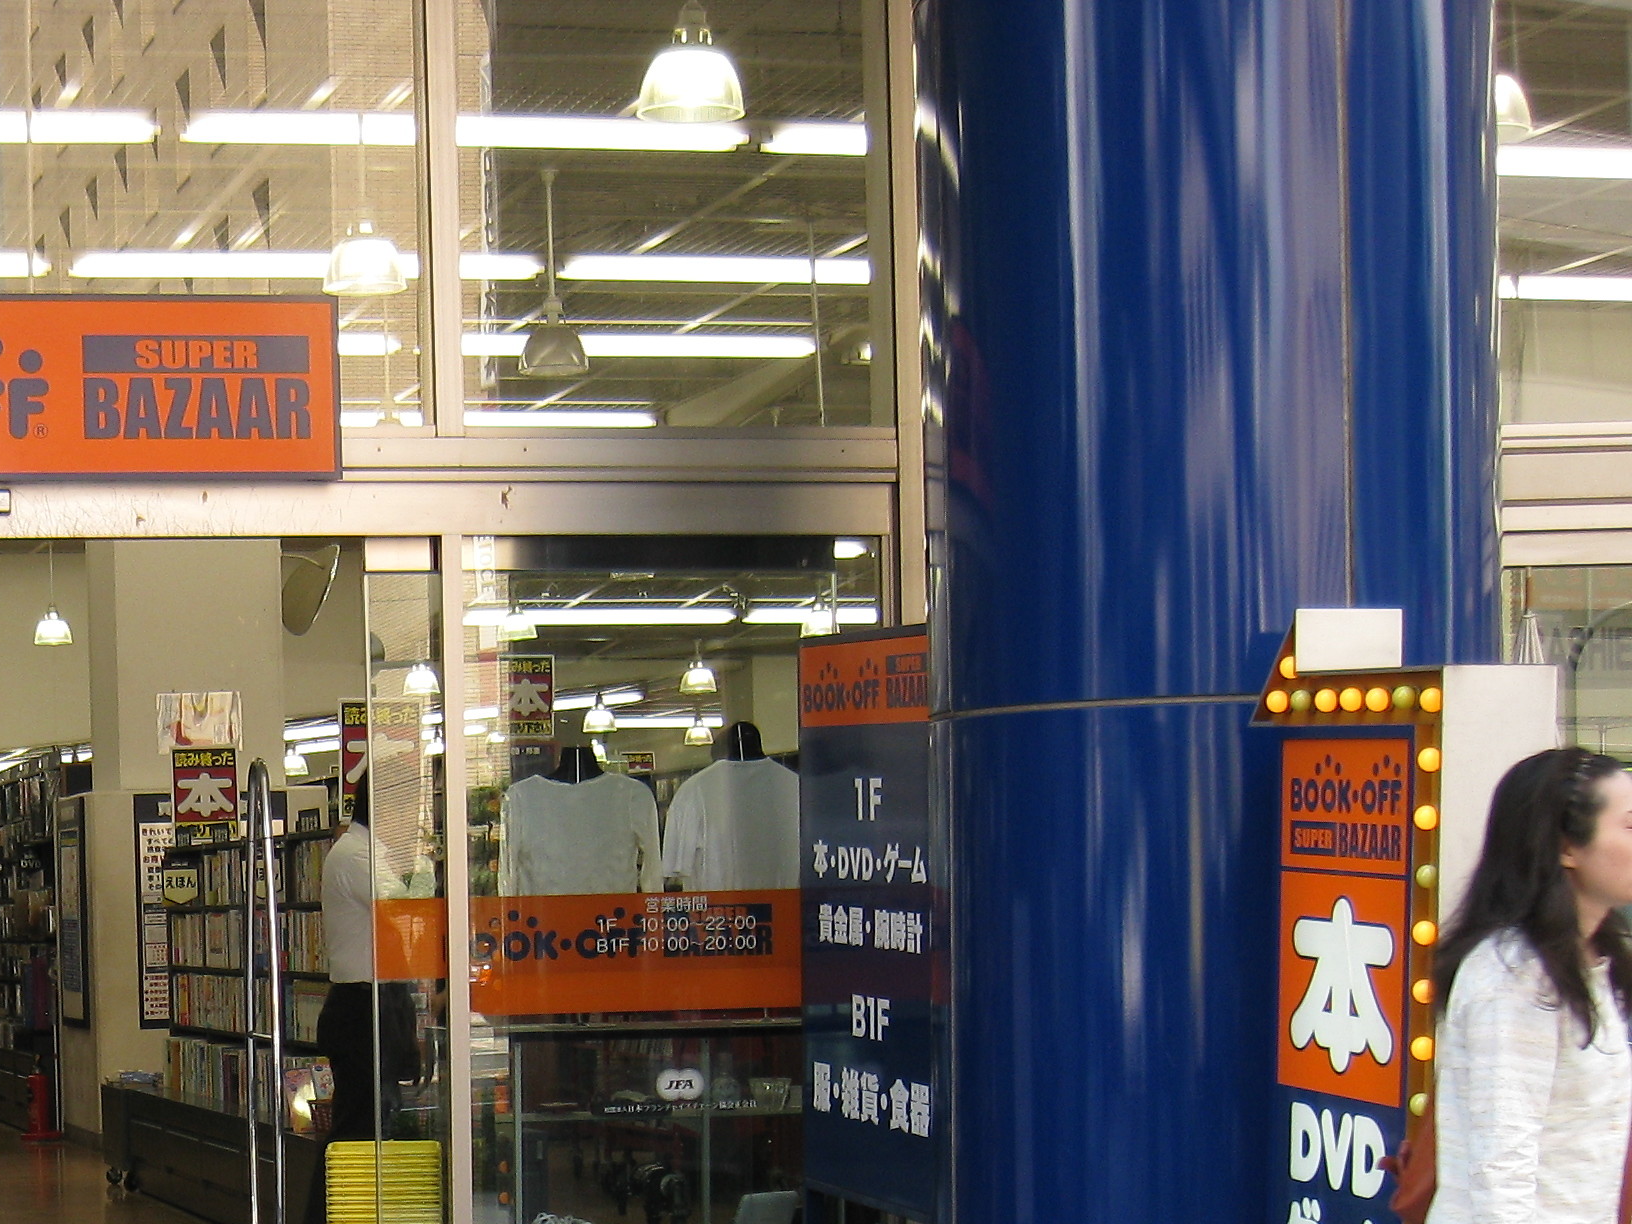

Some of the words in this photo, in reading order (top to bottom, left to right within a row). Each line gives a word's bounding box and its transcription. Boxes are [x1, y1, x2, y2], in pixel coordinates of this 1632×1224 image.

[134, 341, 257, 369] SUPER
[83, 377, 311, 440] BAZAAR
[176, 772, 235, 818] 本
[854, 778, 882, 821] 1F
[812, 840, 927, 884] 本・DVD・ゲーム
[1294, 827, 1333, 849] SUPER
[1338, 822, 1401, 861] BAZAAR
[165, 876, 196, 890] えほん
[644, 896, 707, 913] 営業時間
[596, 938, 629, 953] B1F
[597, 918, 617, 932] 1F
[818, 903, 923, 954] 貴金属・腕時計
[1289, 895, 1394, 1074] 本
[852, 993, 891, 1041] B1F
[665, 1079, 694, 1090] JFA
[1289, 1101, 1386, 1198] DVD
